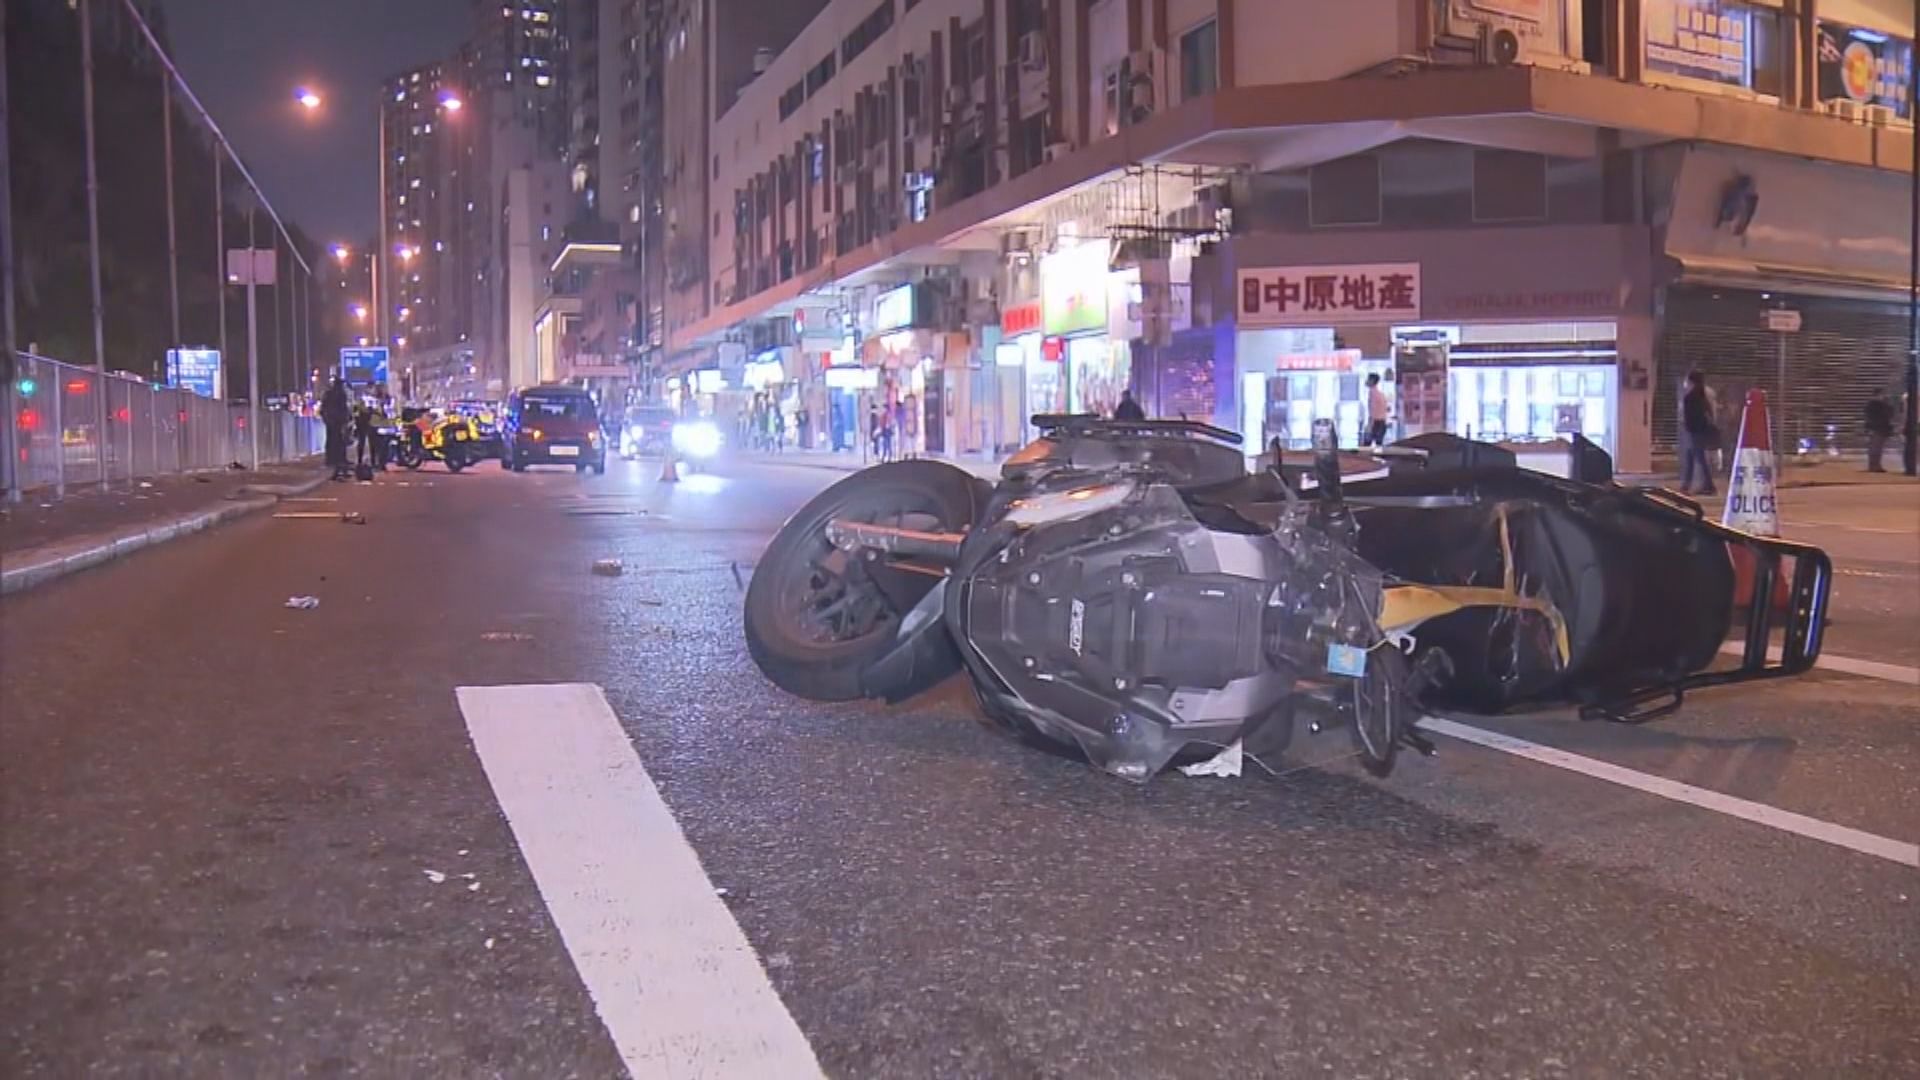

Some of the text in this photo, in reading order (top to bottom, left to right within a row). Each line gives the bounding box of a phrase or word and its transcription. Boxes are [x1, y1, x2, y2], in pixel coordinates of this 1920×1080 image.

[1264, 274, 1415, 312] 中原地產
[1730, 495, 1775, 514] OLICE
